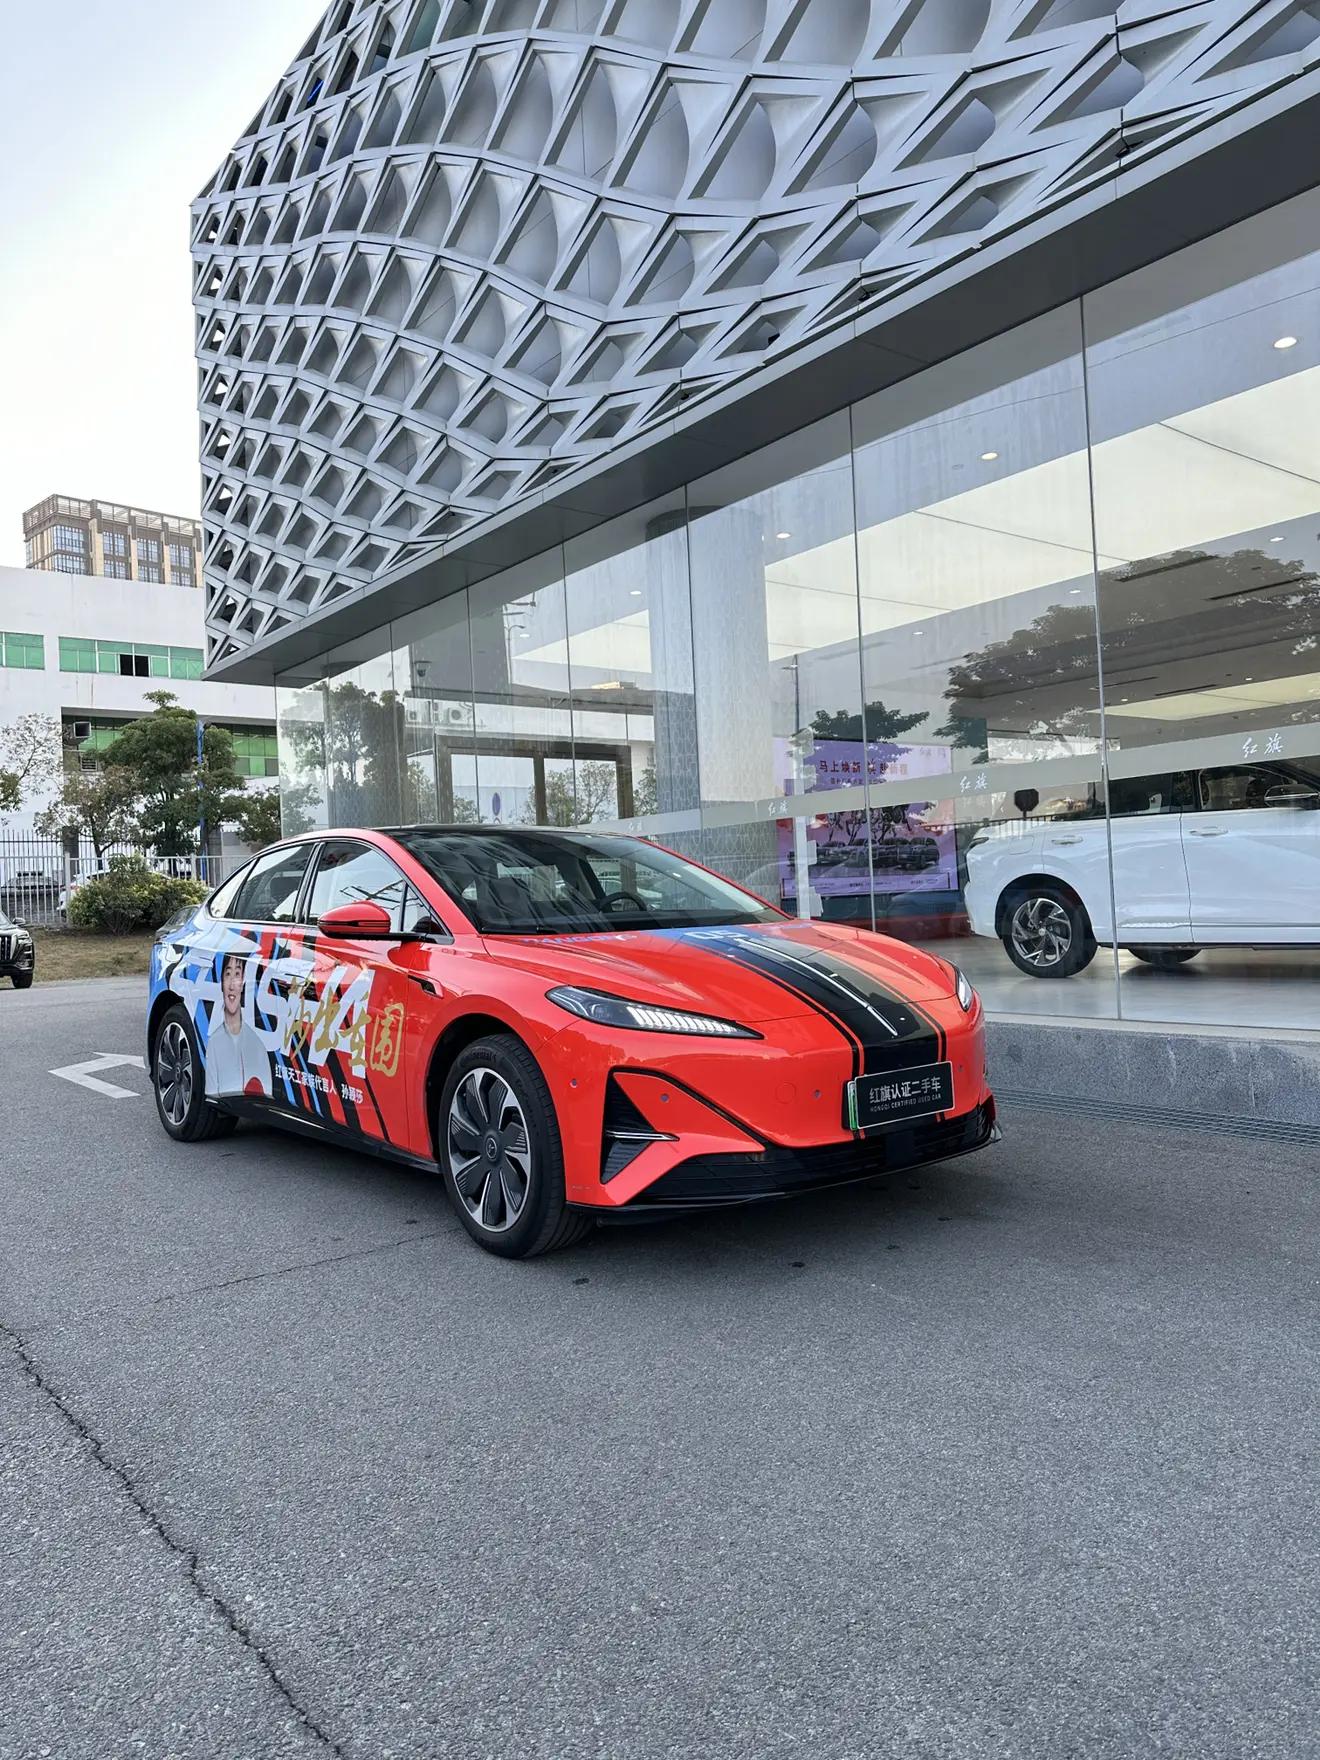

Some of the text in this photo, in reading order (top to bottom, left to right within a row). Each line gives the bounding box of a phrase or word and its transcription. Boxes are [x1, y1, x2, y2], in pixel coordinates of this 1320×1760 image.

[1242, 732, 1284, 759] 红旗
[959, 772, 988, 793] 红旗
[767, 800, 789, 815] 红旗
[869, 1077, 942, 1104] 红旗认证二手车
[870, 1104, 890, 1113] HONGQI
[891, 1098, 917, 1109] CERTIFIED
[918, 1096, 931, 1104] USED
